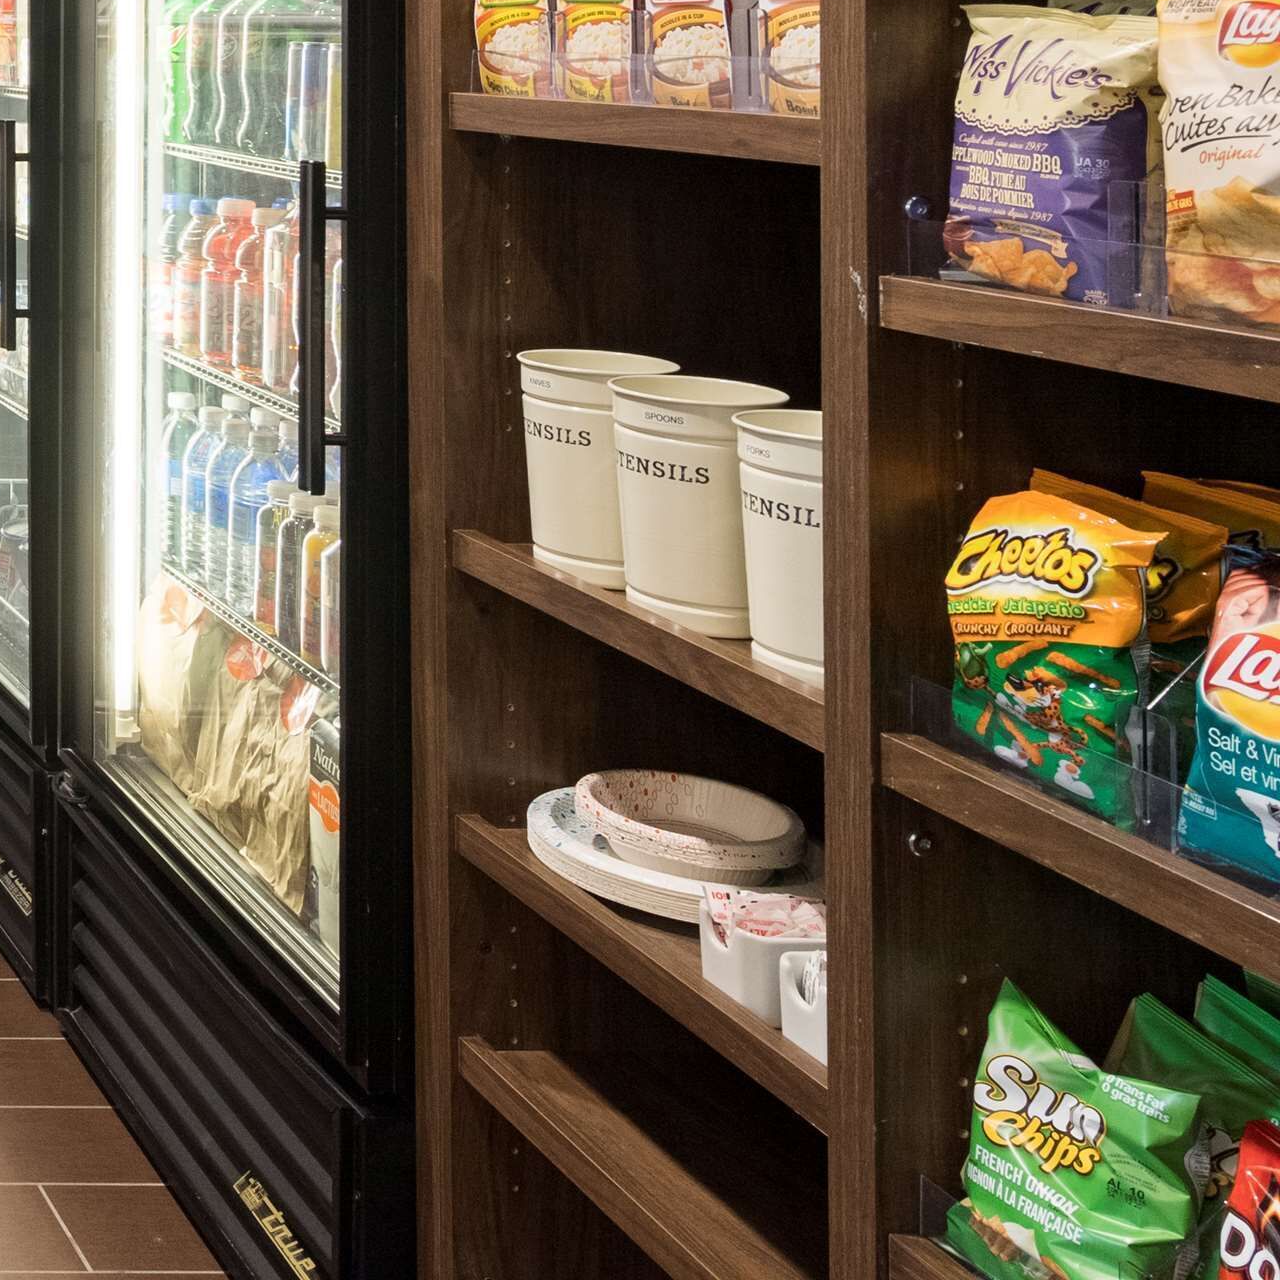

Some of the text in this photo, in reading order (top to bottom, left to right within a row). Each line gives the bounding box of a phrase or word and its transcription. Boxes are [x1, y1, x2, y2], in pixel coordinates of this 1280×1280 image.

[963, 34, 1113, 101] Miss Vickie's
[1024, 141, 1048, 153] 1987
[1165, 112, 1229, 152] Cuites
[1033, 153, 1063, 175] BBQ
[1199, 143, 1265, 170] Original
[969, 165, 1027, 191] BBQ FUMÉ AU
[960, 183, 980, 201] BOIS
[980, 186, 991, 202] DE
[992, 189, 1035, 209] POMMIER
[1030, 210, 1054, 224] 1987
[525, 419, 592, 448] ENSILS
[644, 410, 685, 426] SPOONS
[614, 449, 711, 486] TENSILS
[746, 444, 771, 459] FORKS
[944, 528, 1098, 594] Cheetos
[1002, 596, 1085, 620] Jalapeño
[954, 621, 1072, 637] CRUNCHY CROQUANT
[1208, 726, 1259, 761] Salt &
[1210, 751, 1258, 785] Sel et
[973, 1055, 1105, 1148] Sun
[1110, 1087, 1137, 1109] gras
[1137, 1102, 1170, 1124] trans
[1115, 1078, 1145, 1100] Trans
[1145, 1092, 1167, 1111] Fat
[983, 1110, 1101, 1174] Chips
[975, 1144, 1023, 1185] FRENCH
[995, 1180, 1004, 1200] À
[1004, 1187, 1017, 1209] LA
[1016, 1193, 1083, 1246] FRANÇAISE
